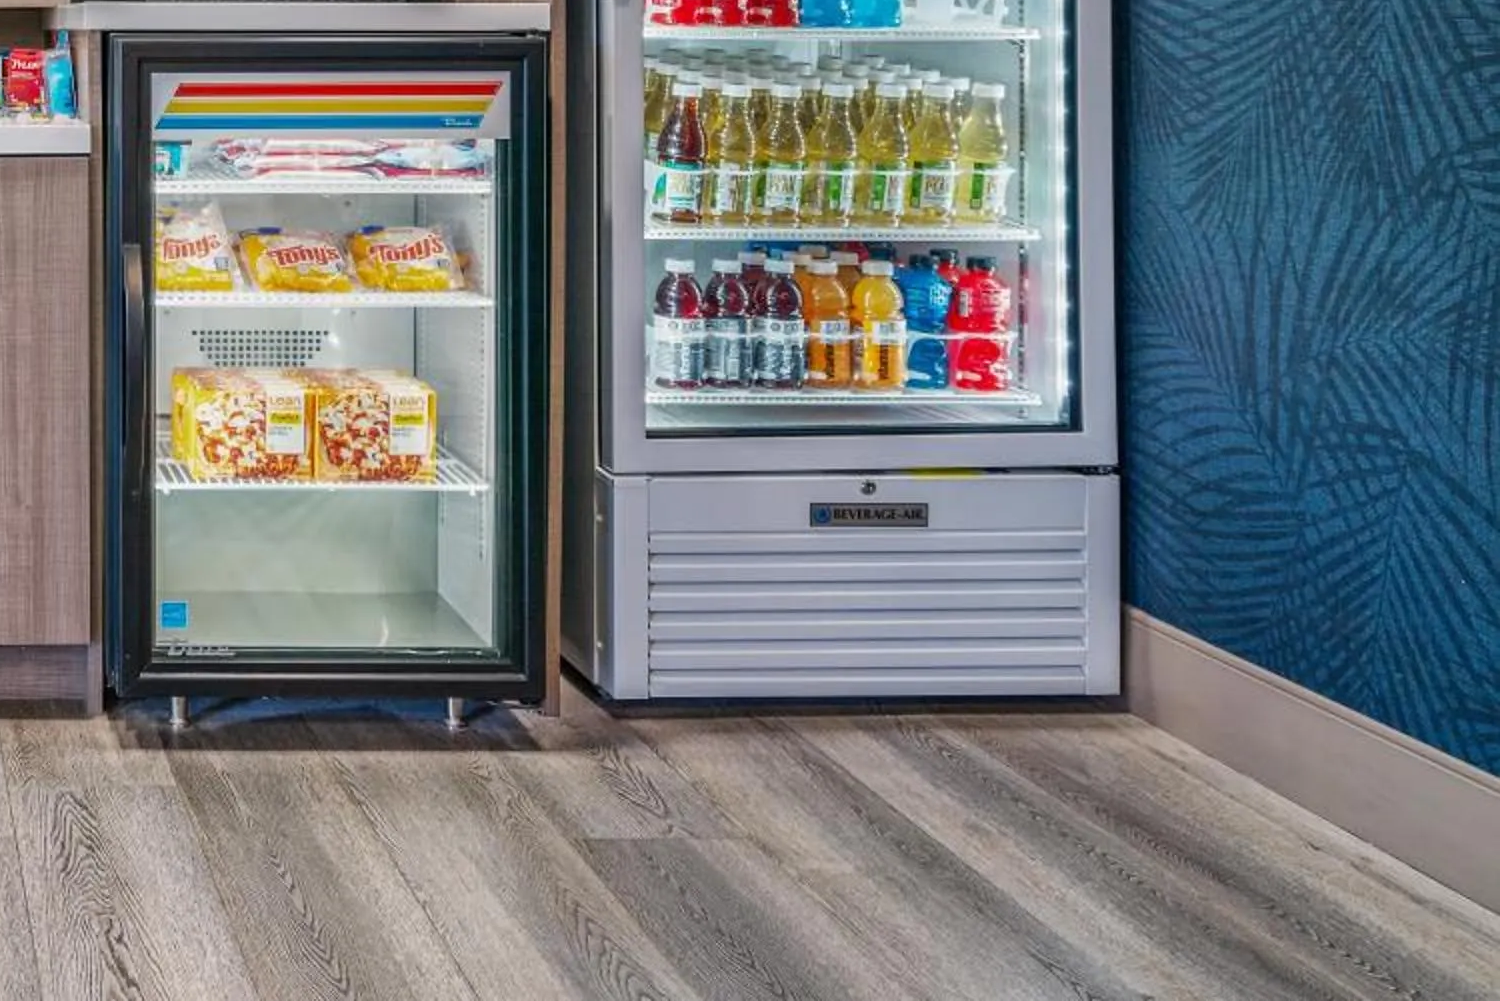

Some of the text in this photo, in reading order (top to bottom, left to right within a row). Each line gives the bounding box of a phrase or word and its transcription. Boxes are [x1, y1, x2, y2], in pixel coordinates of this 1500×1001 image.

[162, 233, 220, 262] Tony's
[268, 243, 341, 267] Tony's
[371, 232, 445, 265] Tony's
[833, 508, 925, 520] BEVERAGE-AIR
